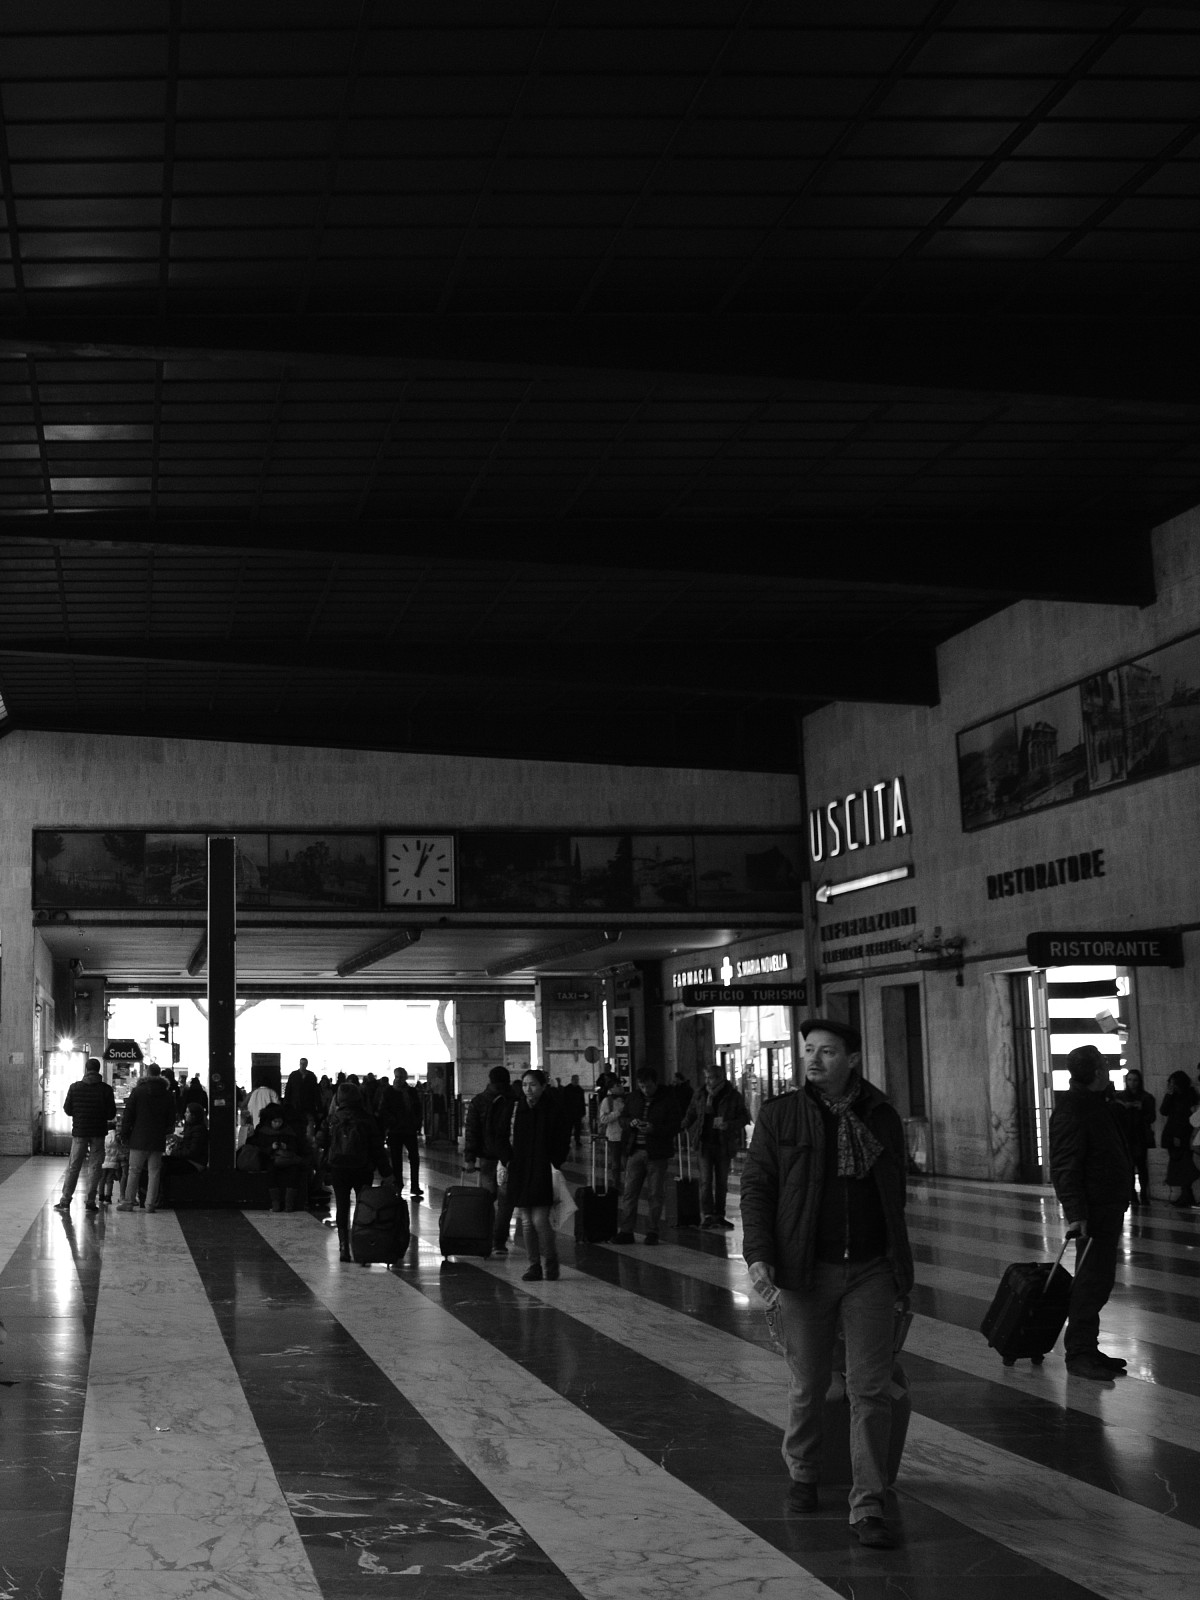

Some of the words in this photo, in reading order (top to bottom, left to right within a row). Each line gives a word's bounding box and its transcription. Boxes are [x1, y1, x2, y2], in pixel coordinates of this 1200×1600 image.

[809, 776, 907, 862] USCITA
[986, 849, 1106, 900] RISTORATORE
[1049, 940, 1161, 957] RISTORANTE
[672, 968, 713, 988] FARMACIA
[694, 989, 745, 1001] UFFICIO
[752, 988, 805, 1001] TURISMO
[109, 1048, 137, 1058] Snack
